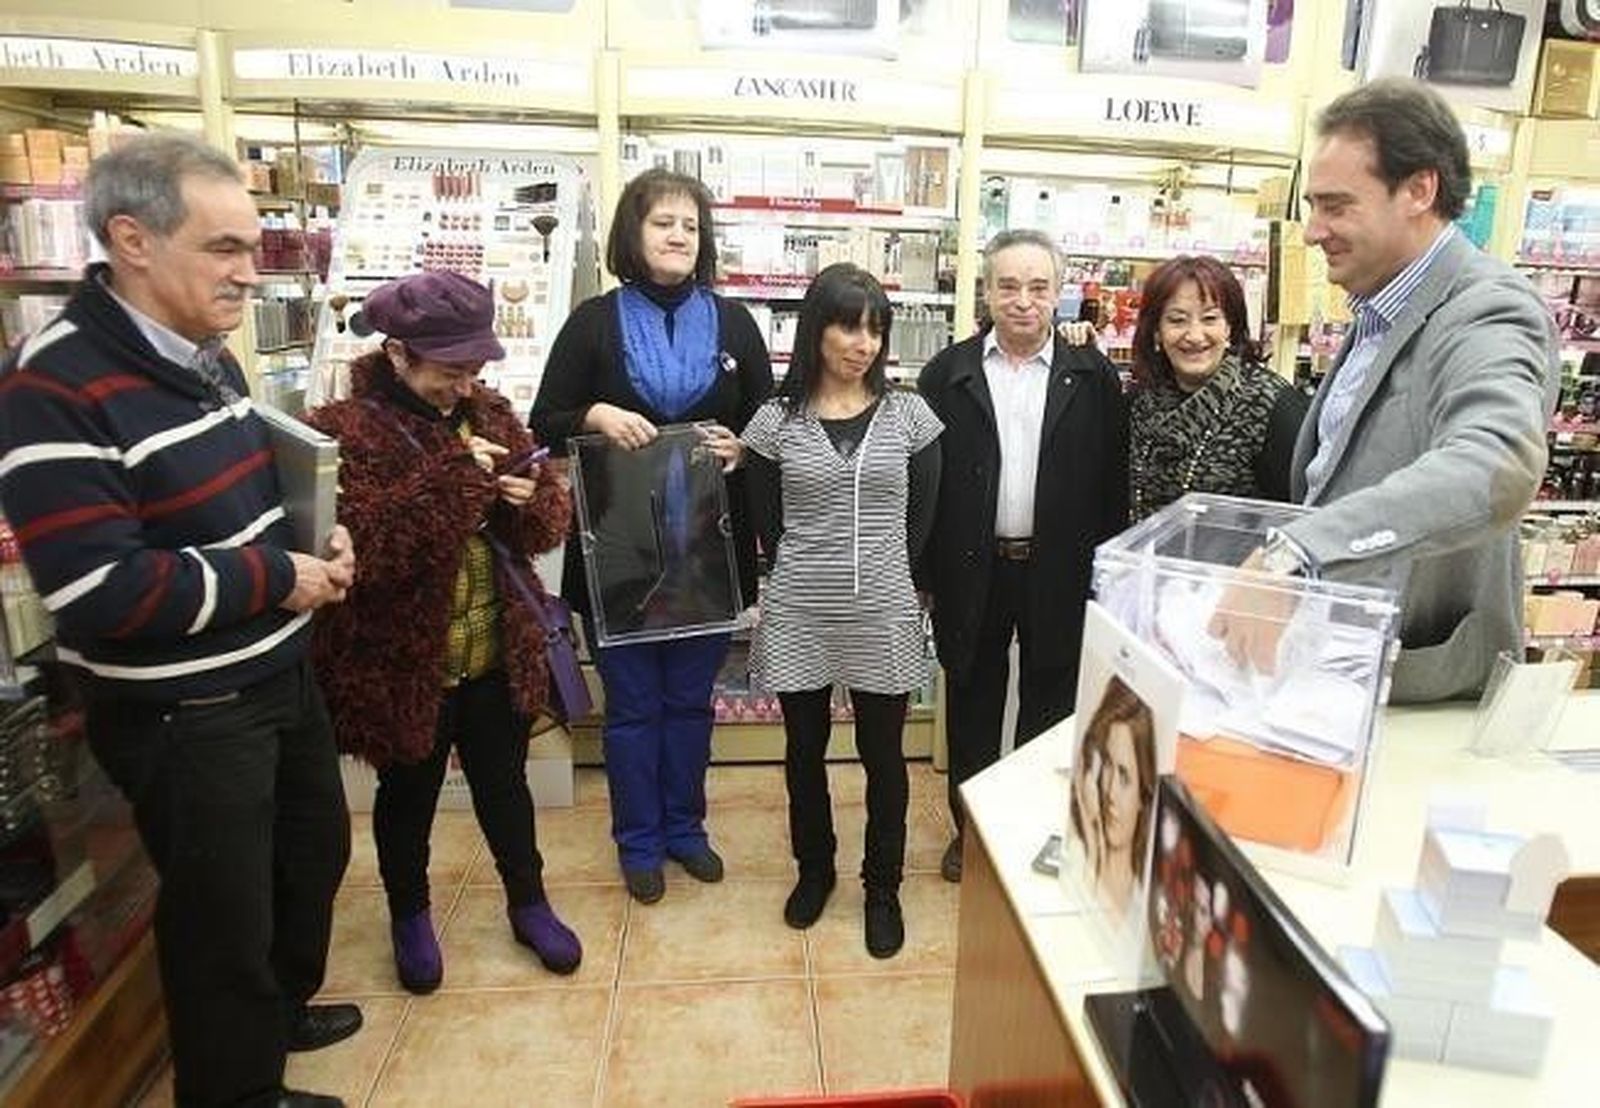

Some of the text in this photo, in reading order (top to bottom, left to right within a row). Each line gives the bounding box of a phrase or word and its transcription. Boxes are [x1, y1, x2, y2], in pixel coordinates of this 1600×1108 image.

[88, 47, 181, 76] Arden
[286, 52, 520, 86] Elizabeth Arden
[734, 76, 857, 102] LANCASTER
[1103, 97, 1202, 127] LOEWE
[393, 155, 556, 175] Elizabeth Arden
